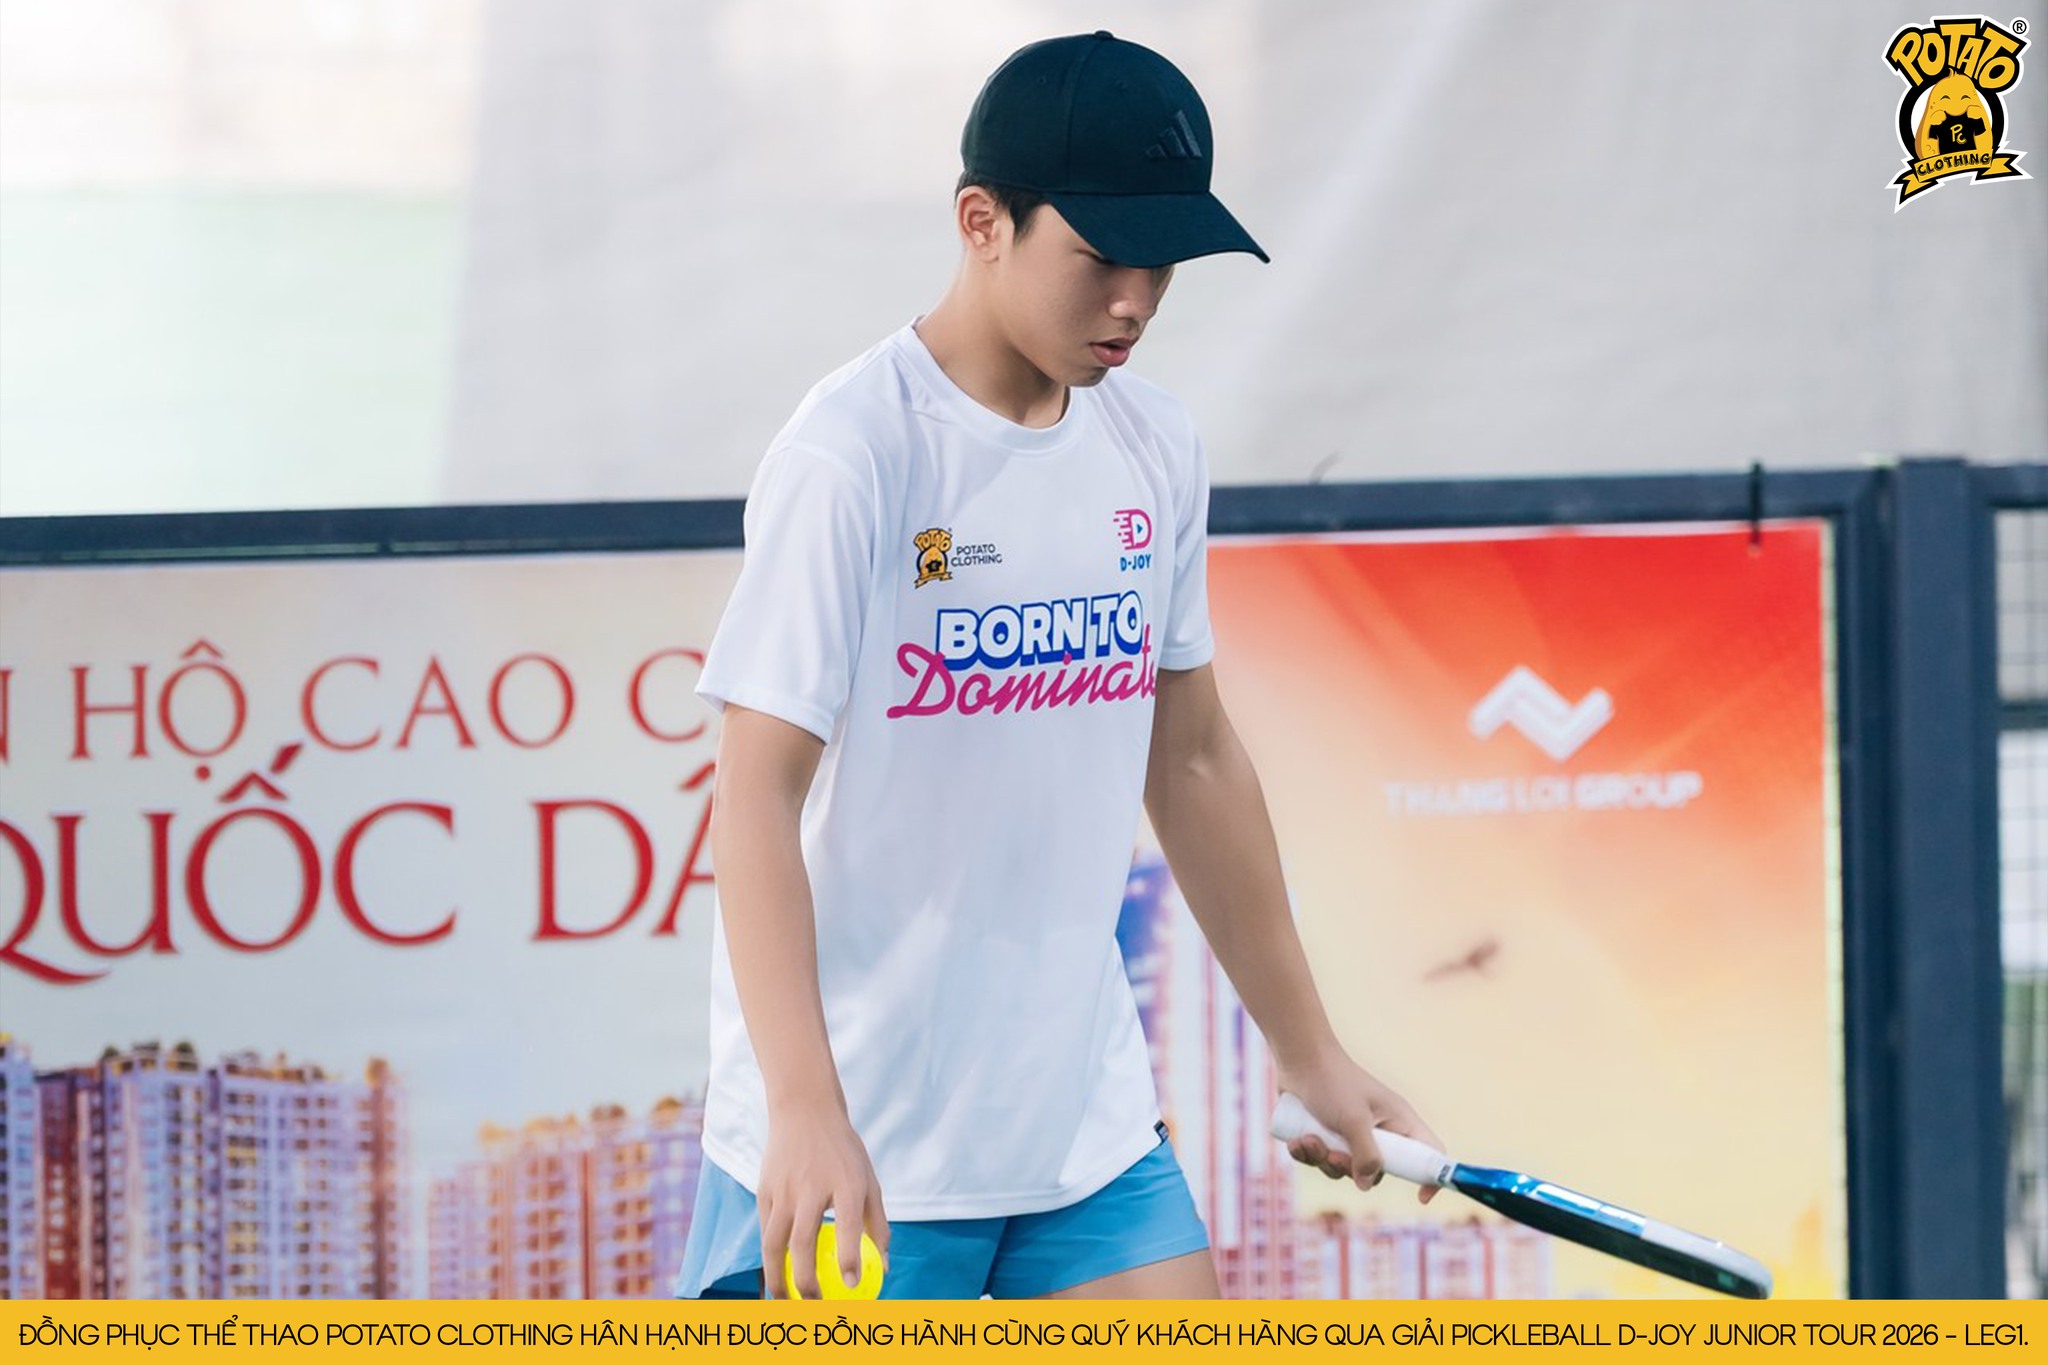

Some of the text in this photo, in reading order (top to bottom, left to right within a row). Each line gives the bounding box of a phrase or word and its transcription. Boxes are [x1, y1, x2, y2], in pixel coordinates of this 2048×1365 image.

[914, 529, 952, 552] POTATO
[956, 543, 996, 556] POTATO
[950, 554, 1003, 567] CLOTHING
[1120, 553, 1151, 571] D-JOY
[936, 589, 1144, 671] BORN TO
[69, 637, 248, 782] HỘ
[300, 652, 577, 752] CAO
